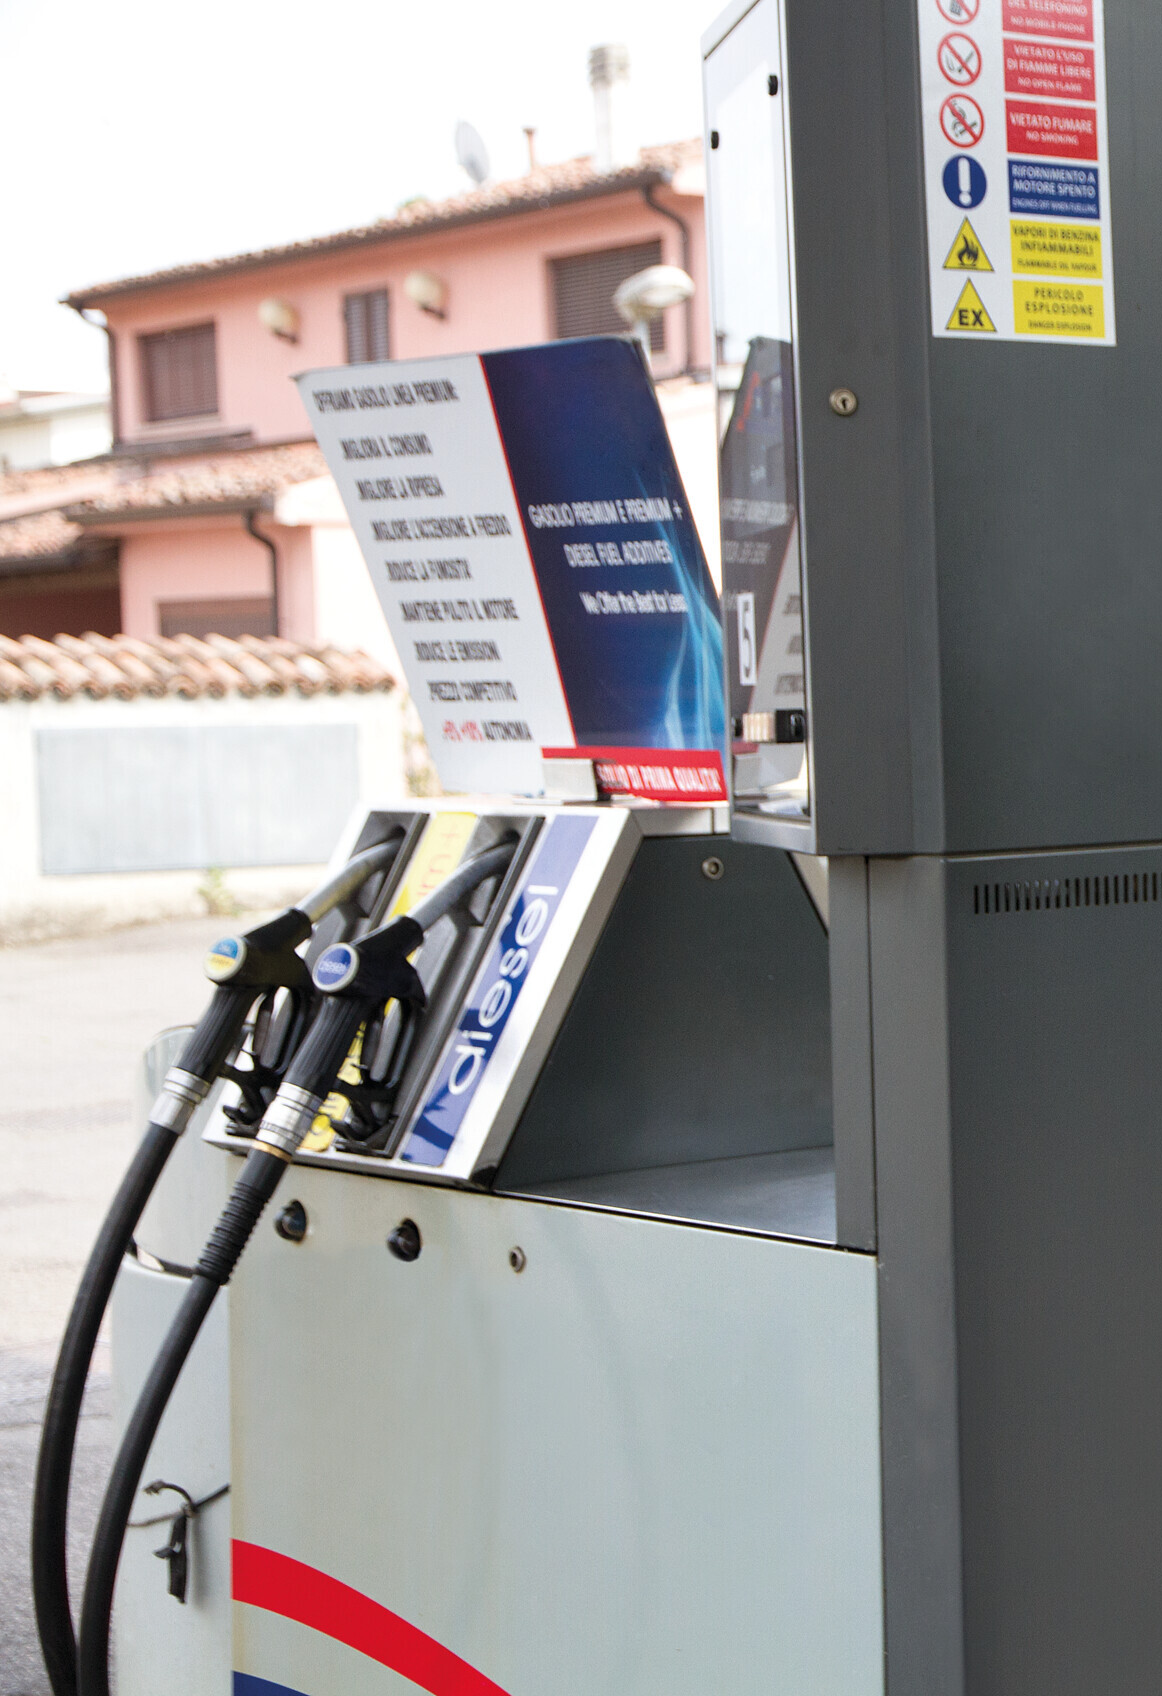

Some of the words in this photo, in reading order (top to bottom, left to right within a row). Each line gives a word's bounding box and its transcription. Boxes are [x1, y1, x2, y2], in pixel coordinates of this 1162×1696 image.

[1014, 45, 1054, 59] VIETATO
[1007, 58, 1017, 70] DI
[1020, 60, 1058, 74] FIAMME
[1061, 65, 1092, 79] LIBERE
[1010, 112, 1051, 129] VIETATO
[1053, 116, 1092, 133] FUMARE
[1012, 165, 1086, 184] RIFORNIMENTO
[1087, 172, 1096, 184] A
[1013, 178, 1056, 195] MOTORE
[1057, 183, 1096, 198] SPENTO
[1014, 225, 1047, 239] VAPORI
[1050, 228, 1058, 238] DI
[1021, 240, 1094, 256] INFIAMMABILI
[1034, 288, 1084, 301] PERICOLO
[959, 309, 984, 326] EX
[1026, 301, 1094, 316] ESPLOSIONE
[528, 502, 576, 528] GASOLIO
[572, 500, 620, 526] PREMIUM
[616, 499, 628, 524] E
[624, 497, 674, 522] PREMIUM
[564, 543, 600, 568] DIESEL
[596, 542, 624, 566] FUEL
[449, 884, 559, 1096] diesel
